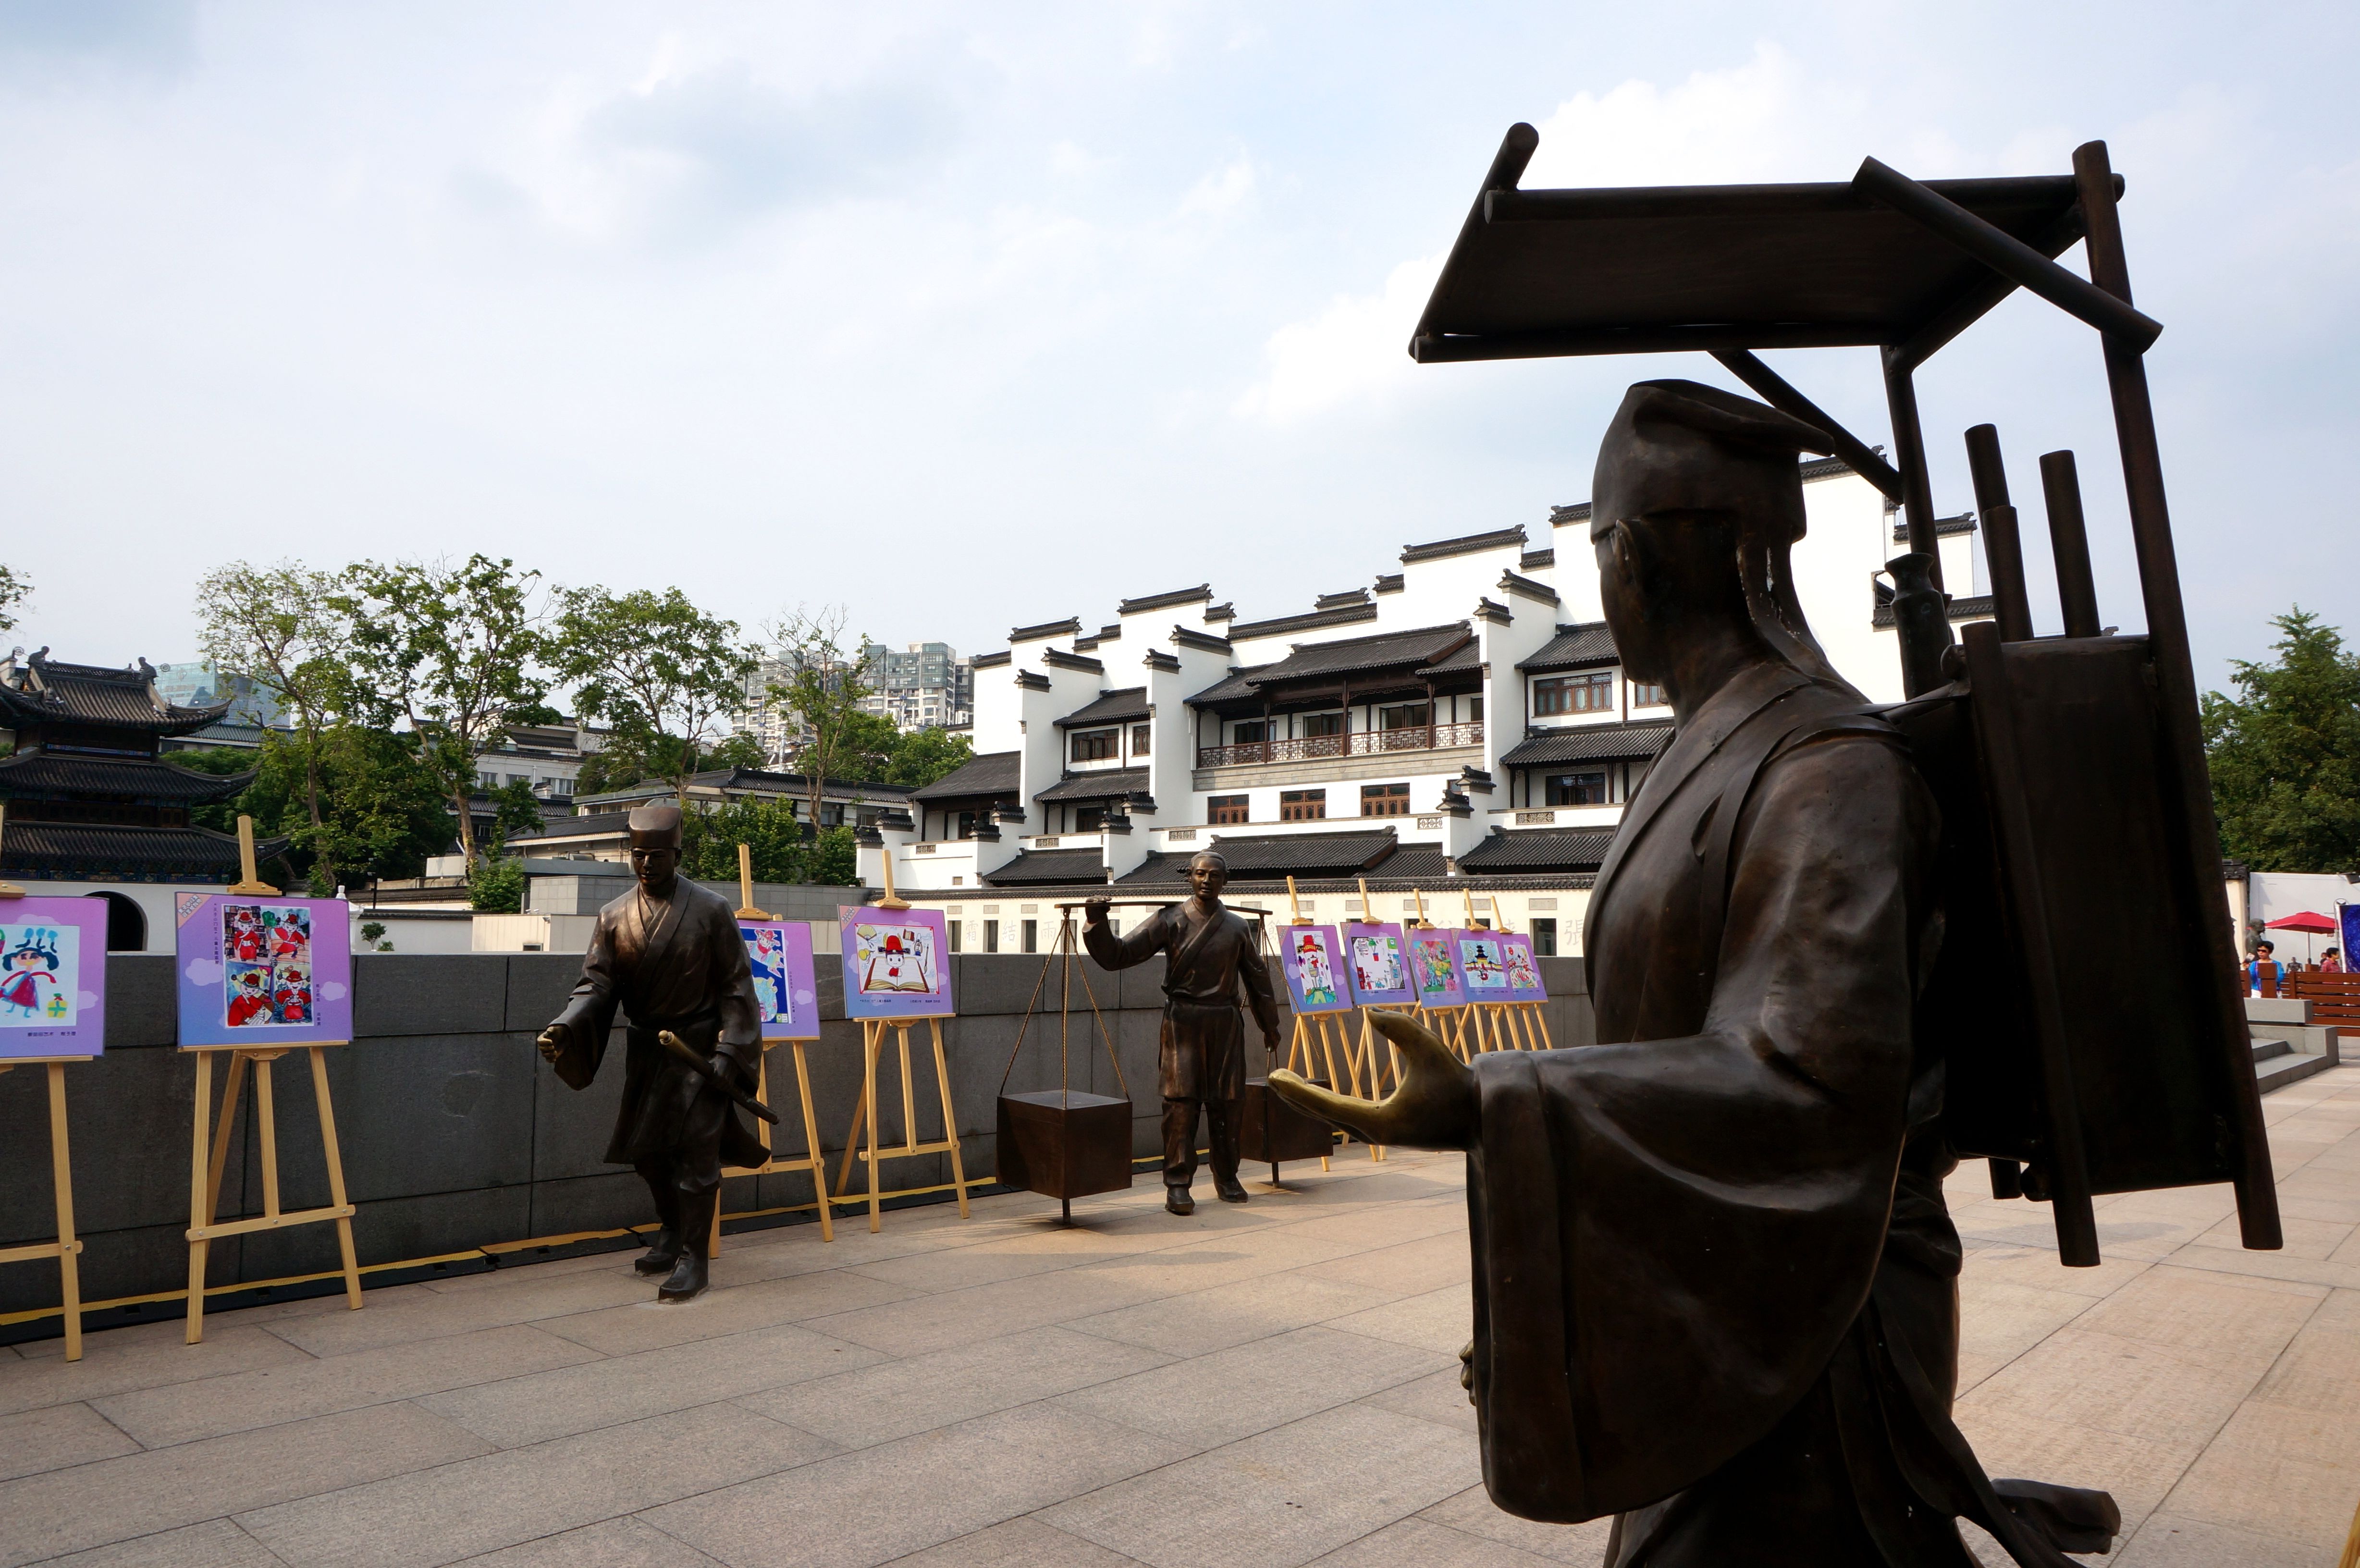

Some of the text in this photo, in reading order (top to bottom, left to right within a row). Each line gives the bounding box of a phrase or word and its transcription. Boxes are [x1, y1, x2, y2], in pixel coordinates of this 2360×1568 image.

[966, 920, 978, 942] 霜
[1002, 920, 1017, 942] 結
[1041, 921, 1057, 941] 雨
[1564, 919, 1584, 946] 張
